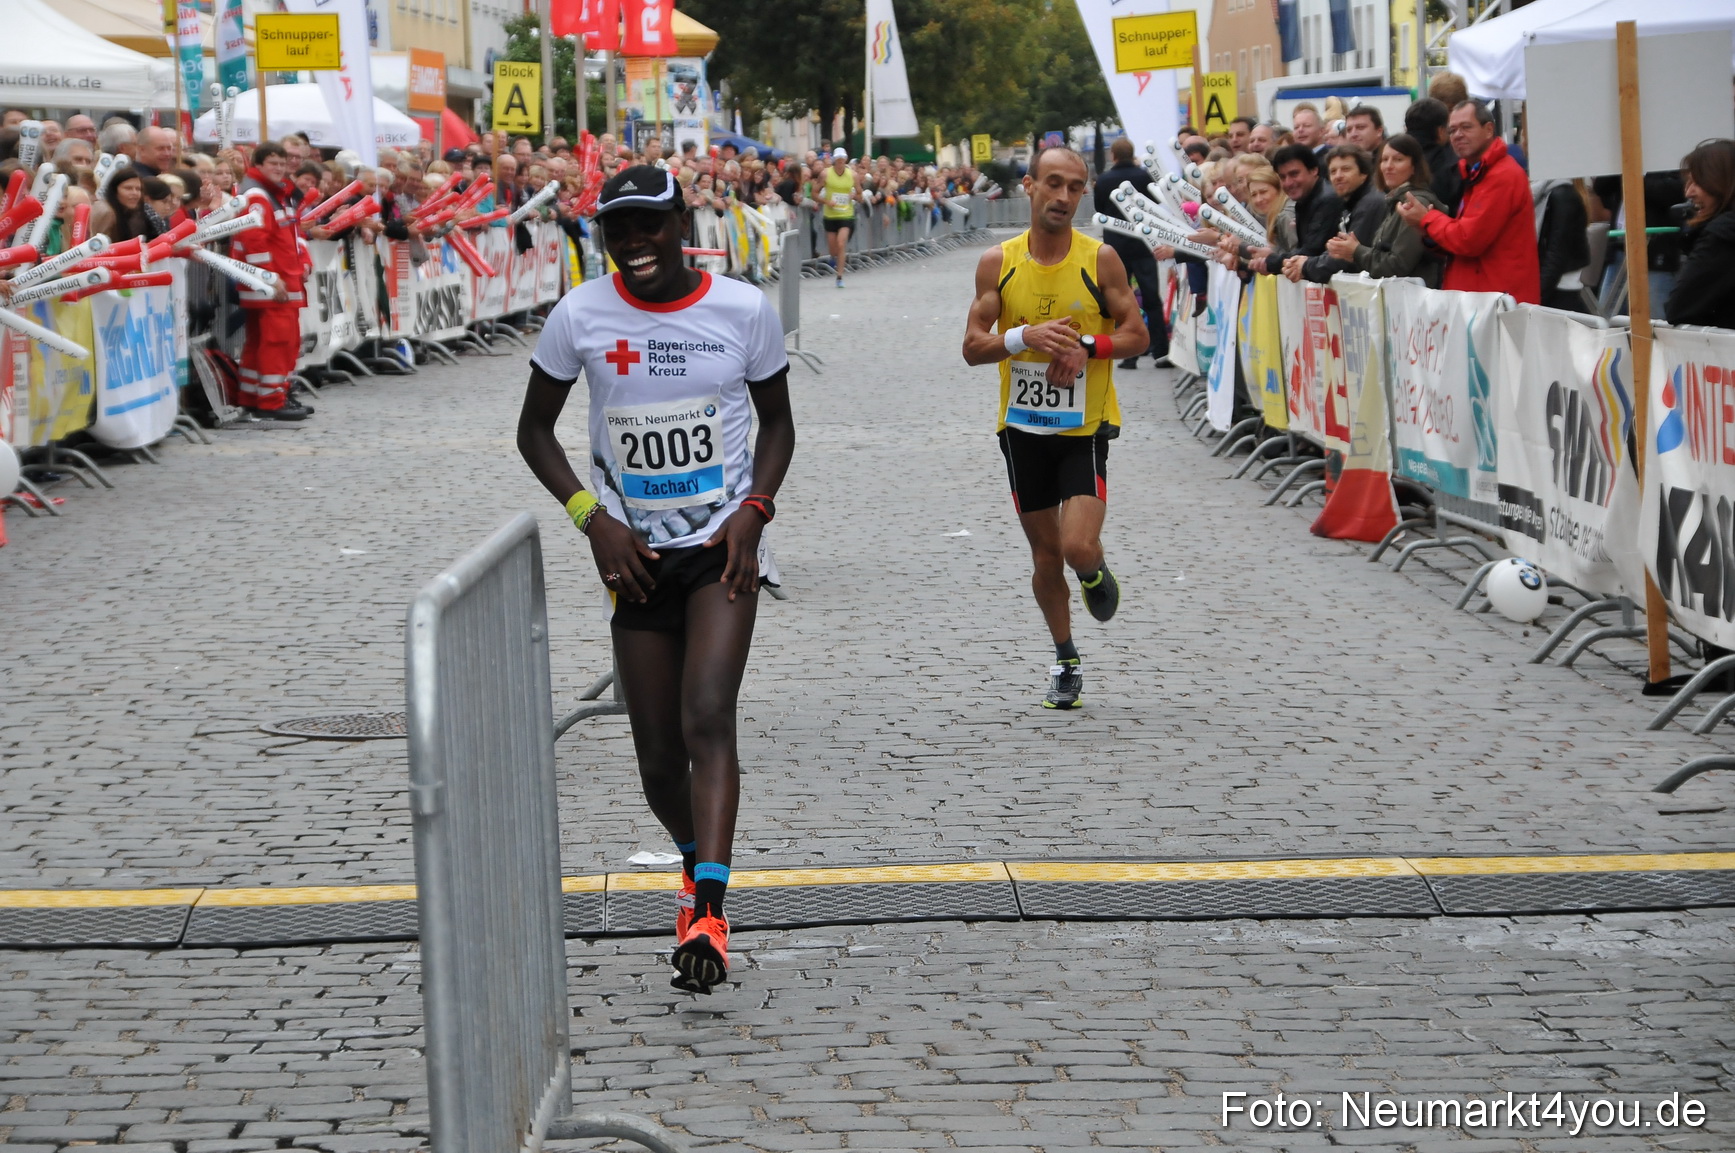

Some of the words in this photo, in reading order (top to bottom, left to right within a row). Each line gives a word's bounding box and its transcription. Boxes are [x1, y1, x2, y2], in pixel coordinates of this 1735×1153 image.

[260, 29, 334, 42] Schnupper-
[1119, 28, 1192, 43] Schnupper-
[285, 44, 311, 56] lauf
[1144, 44, 1169, 56] lauf
[499, 64, 534, 77] Block
[503, 83, 528, 116] A
[1205, 93, 1228, 125] A
[1183, 181, 1202, 199] bmw-
[1157, 230, 1181, 245] BMW
[648, 339, 725, 353] Bayerisches
[648, 352, 686, 364] Rotes
[649, 365, 687, 377] Kreuz
[1011, 367, 1032, 377] PARTL
[1016, 379, 1074, 408] 2351
[608, 416, 643, 427] PARTL
[645, 410, 701, 425] Neumarkt
[1027, 413, 1061, 426] Jürgen
[1686, 361, 1735, 466] INTE
[620, 424, 714, 470] 2003
[642, 477, 699, 496] Zachary
